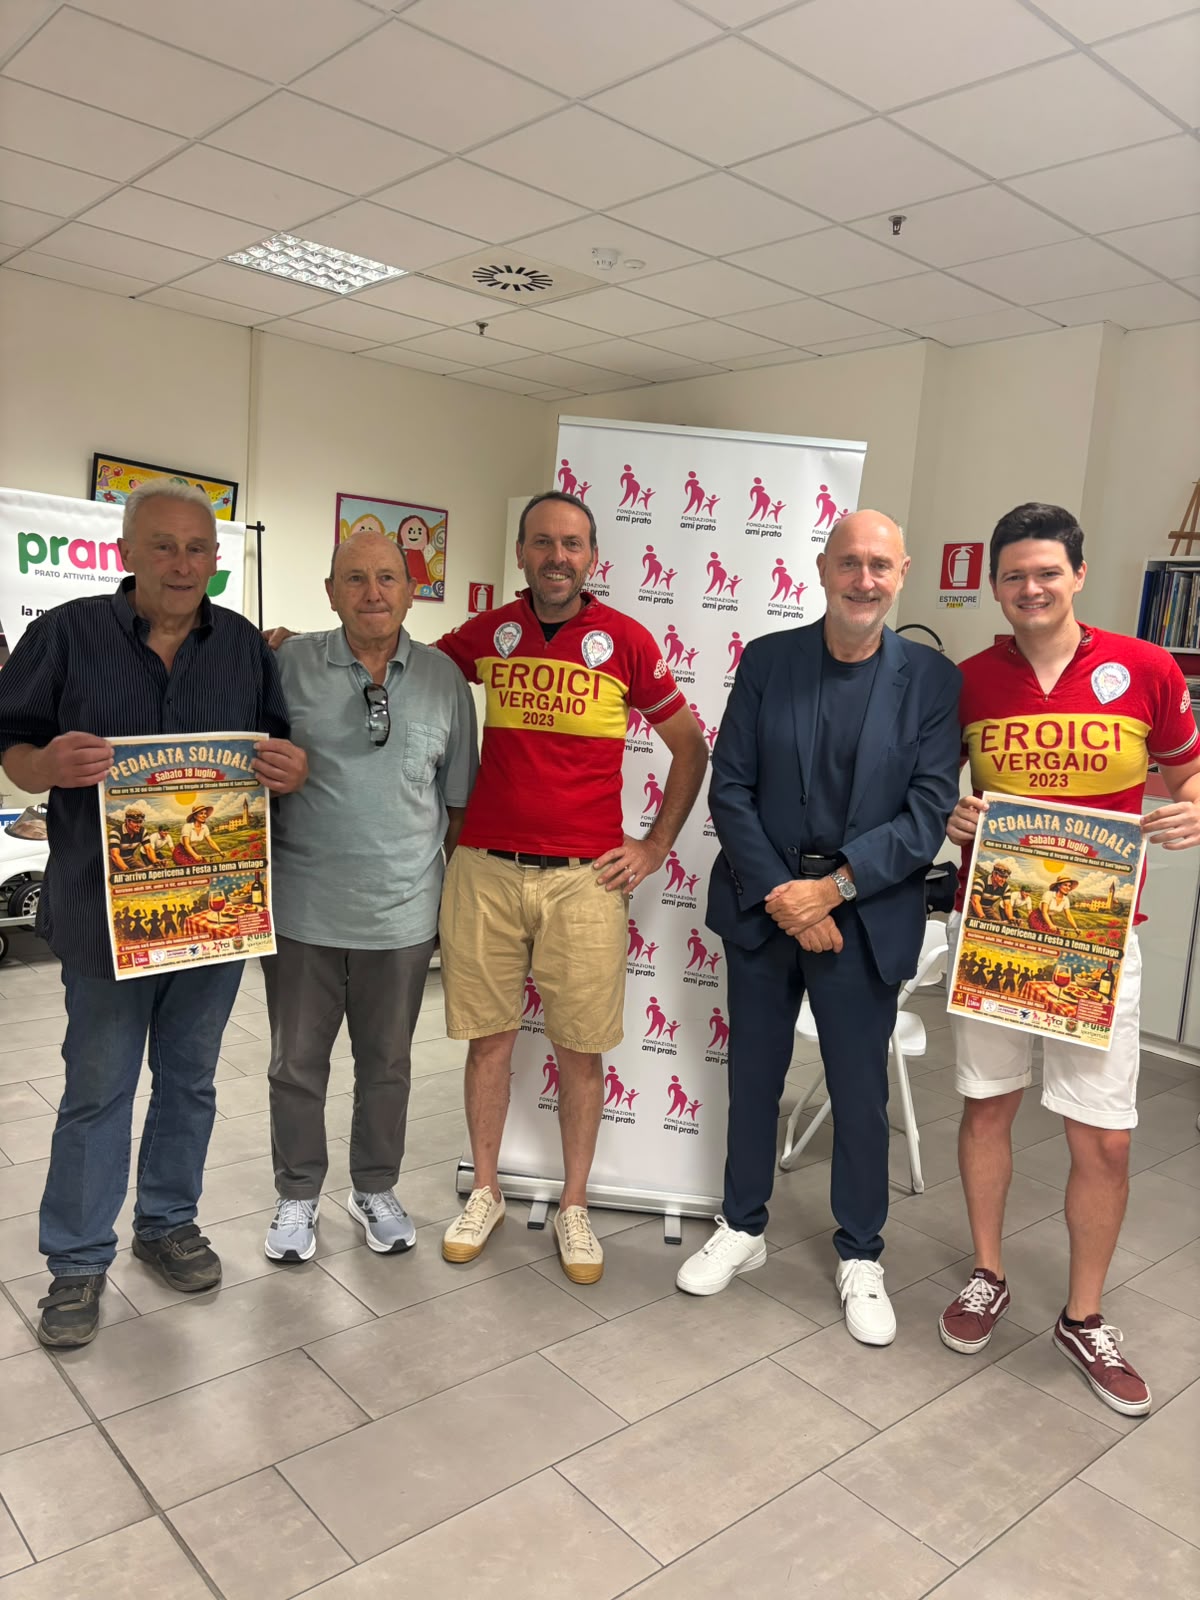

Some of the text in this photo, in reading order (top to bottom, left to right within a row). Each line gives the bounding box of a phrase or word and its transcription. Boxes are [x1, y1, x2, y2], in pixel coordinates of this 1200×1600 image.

[631, 516, 652, 524] prato
[680, 522, 716, 532] ami prato
[746, 522, 782, 530] FONDAZIONE
[745, 528, 782, 538] ami prato
[34, 569, 60, 578] PRATO
[63, 572, 96, 582] ATTIVITÀ
[639, 589, 674, 597] FONDAZIONE
[638, 594, 674, 604] ami prato
[703, 596, 739, 604] FONDAZIONE
[22, 605, 32, 616] la
[702, 602, 738, 612] ami prato
[768, 603, 804, 611] FONDAZIONE
[767, 608, 804, 619] ami prato
[491, 662, 600, 700] EROICI
[675, 675, 696, 684] prato
[499, 690, 587, 716] VERGAIO
[522, 712, 554, 726] 2023
[980, 720, 1120, 752] EROICI
[633, 746, 654, 754] prato
[109, 747, 185, 781] PEDALATA
[991, 752, 1108, 772] VERGAIO
[154, 768, 218, 782] Sabato 18 luglio
[1029, 773, 1069, 788] 2023
[988, 813, 1136, 859] PEDALATA SOLIDALE
[1028, 834, 1090, 854] Sabato 18 luglio
[113, 872, 146, 884] All'arrivo
[148, 868, 184, 881] Apericena
[192, 865, 212, 874] Festa
[218, 863, 237, 872] tema
[238, 860, 264, 870] Vintage
[662, 892, 697, 902] FONDAZIONE
[662, 898, 697, 910] ami prato
[968, 918, 1000, 933] All'arrivo
[1001, 924, 1036, 941] Apericena
[1044, 934, 1064, 946] Festa
[1071, 939, 1090, 952] tema
[1092, 943, 1120, 958] Vintage
[635, 968, 656, 977] prato
[684, 970, 719, 980] FONDAZIONE
[683, 976, 719, 988] ami prato
[1090, 1024, 1110, 1032] UISP
[643, 1038, 678, 1048] FONDAZIONE
[642, 1044, 678, 1056] ami prato
[704, 1055, 720, 1063] ami
[538, 1102, 552, 1110] ami
[616, 1115, 636, 1124] prato
[664, 1118, 700, 1128] FONDAZIONE
[664, 1123, 699, 1136] ami prato
